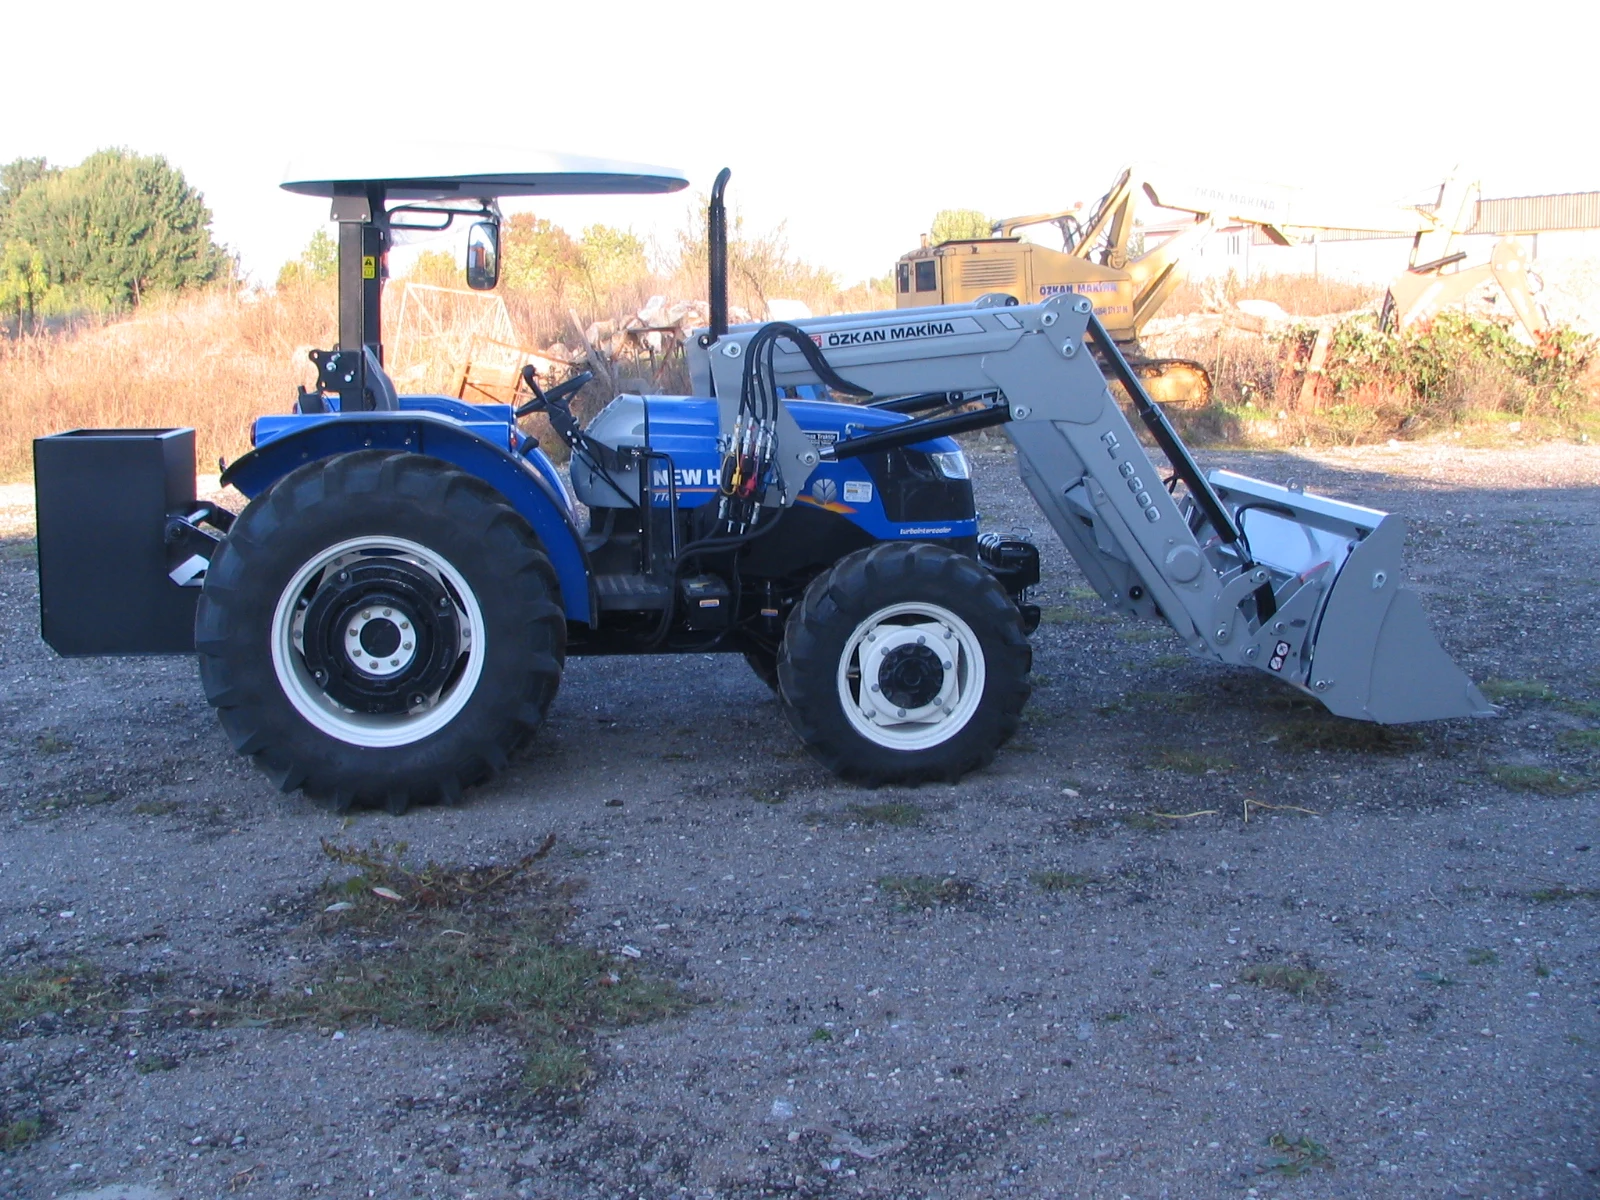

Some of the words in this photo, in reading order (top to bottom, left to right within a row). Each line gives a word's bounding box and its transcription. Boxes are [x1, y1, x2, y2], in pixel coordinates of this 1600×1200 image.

[828, 330, 886, 346] ÖZKAN
[891, 323, 955, 340] MAKİNA
[653, 469, 702, 486] NEW
[1100, 431, 1120, 460] FL
[1118, 461, 1161, 523] 3300
